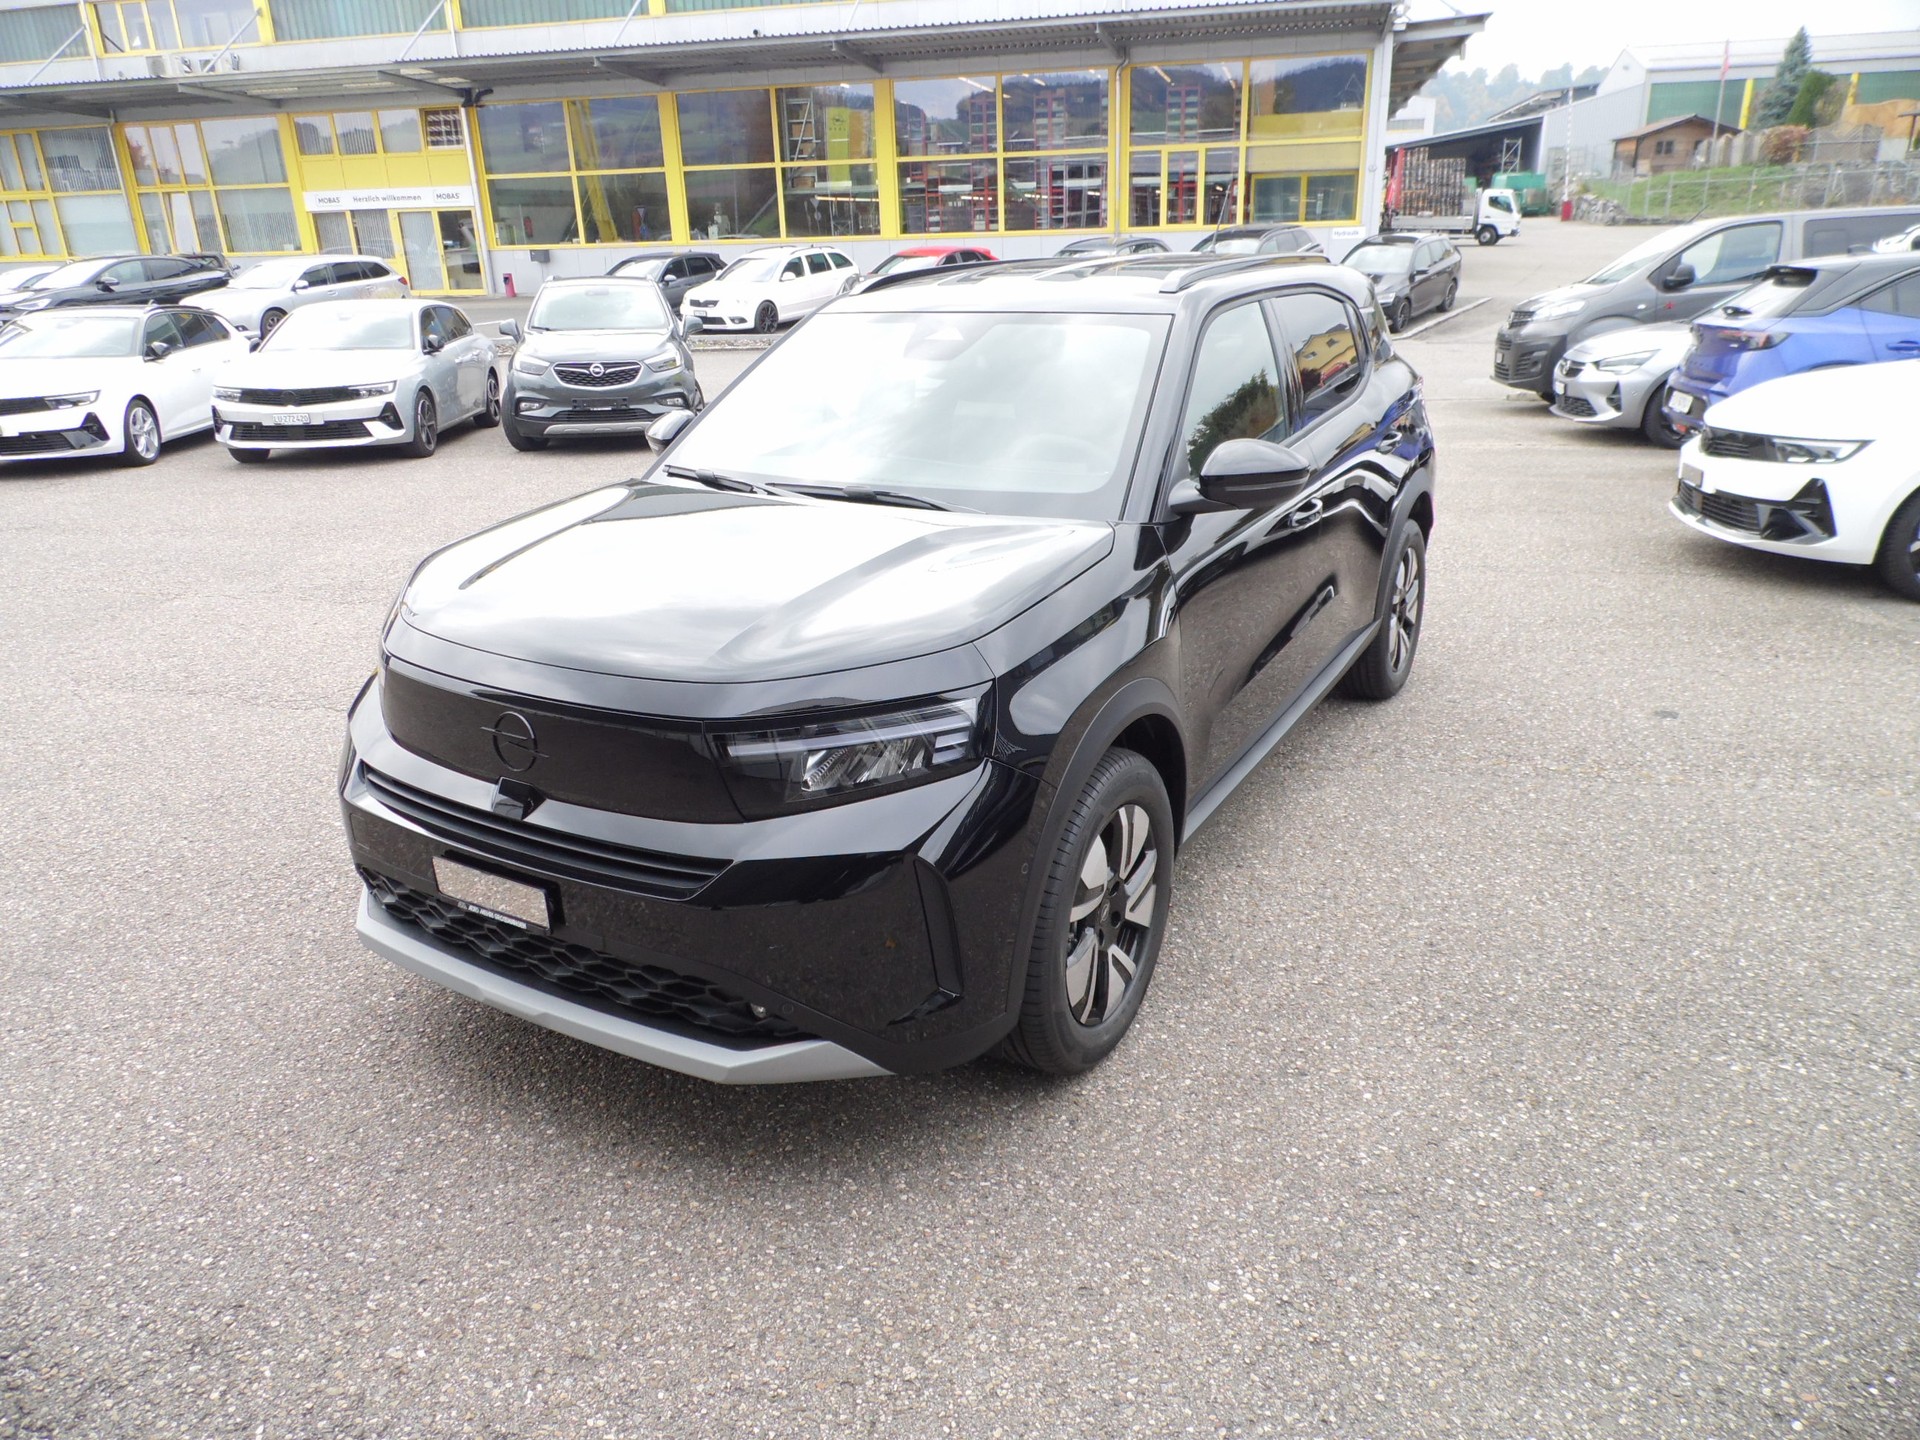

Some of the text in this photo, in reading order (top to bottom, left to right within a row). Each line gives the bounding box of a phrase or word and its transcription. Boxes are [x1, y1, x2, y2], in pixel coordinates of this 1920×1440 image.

[317, 192, 460, 204] MOBAS Herzlich willkommen MOBAS
